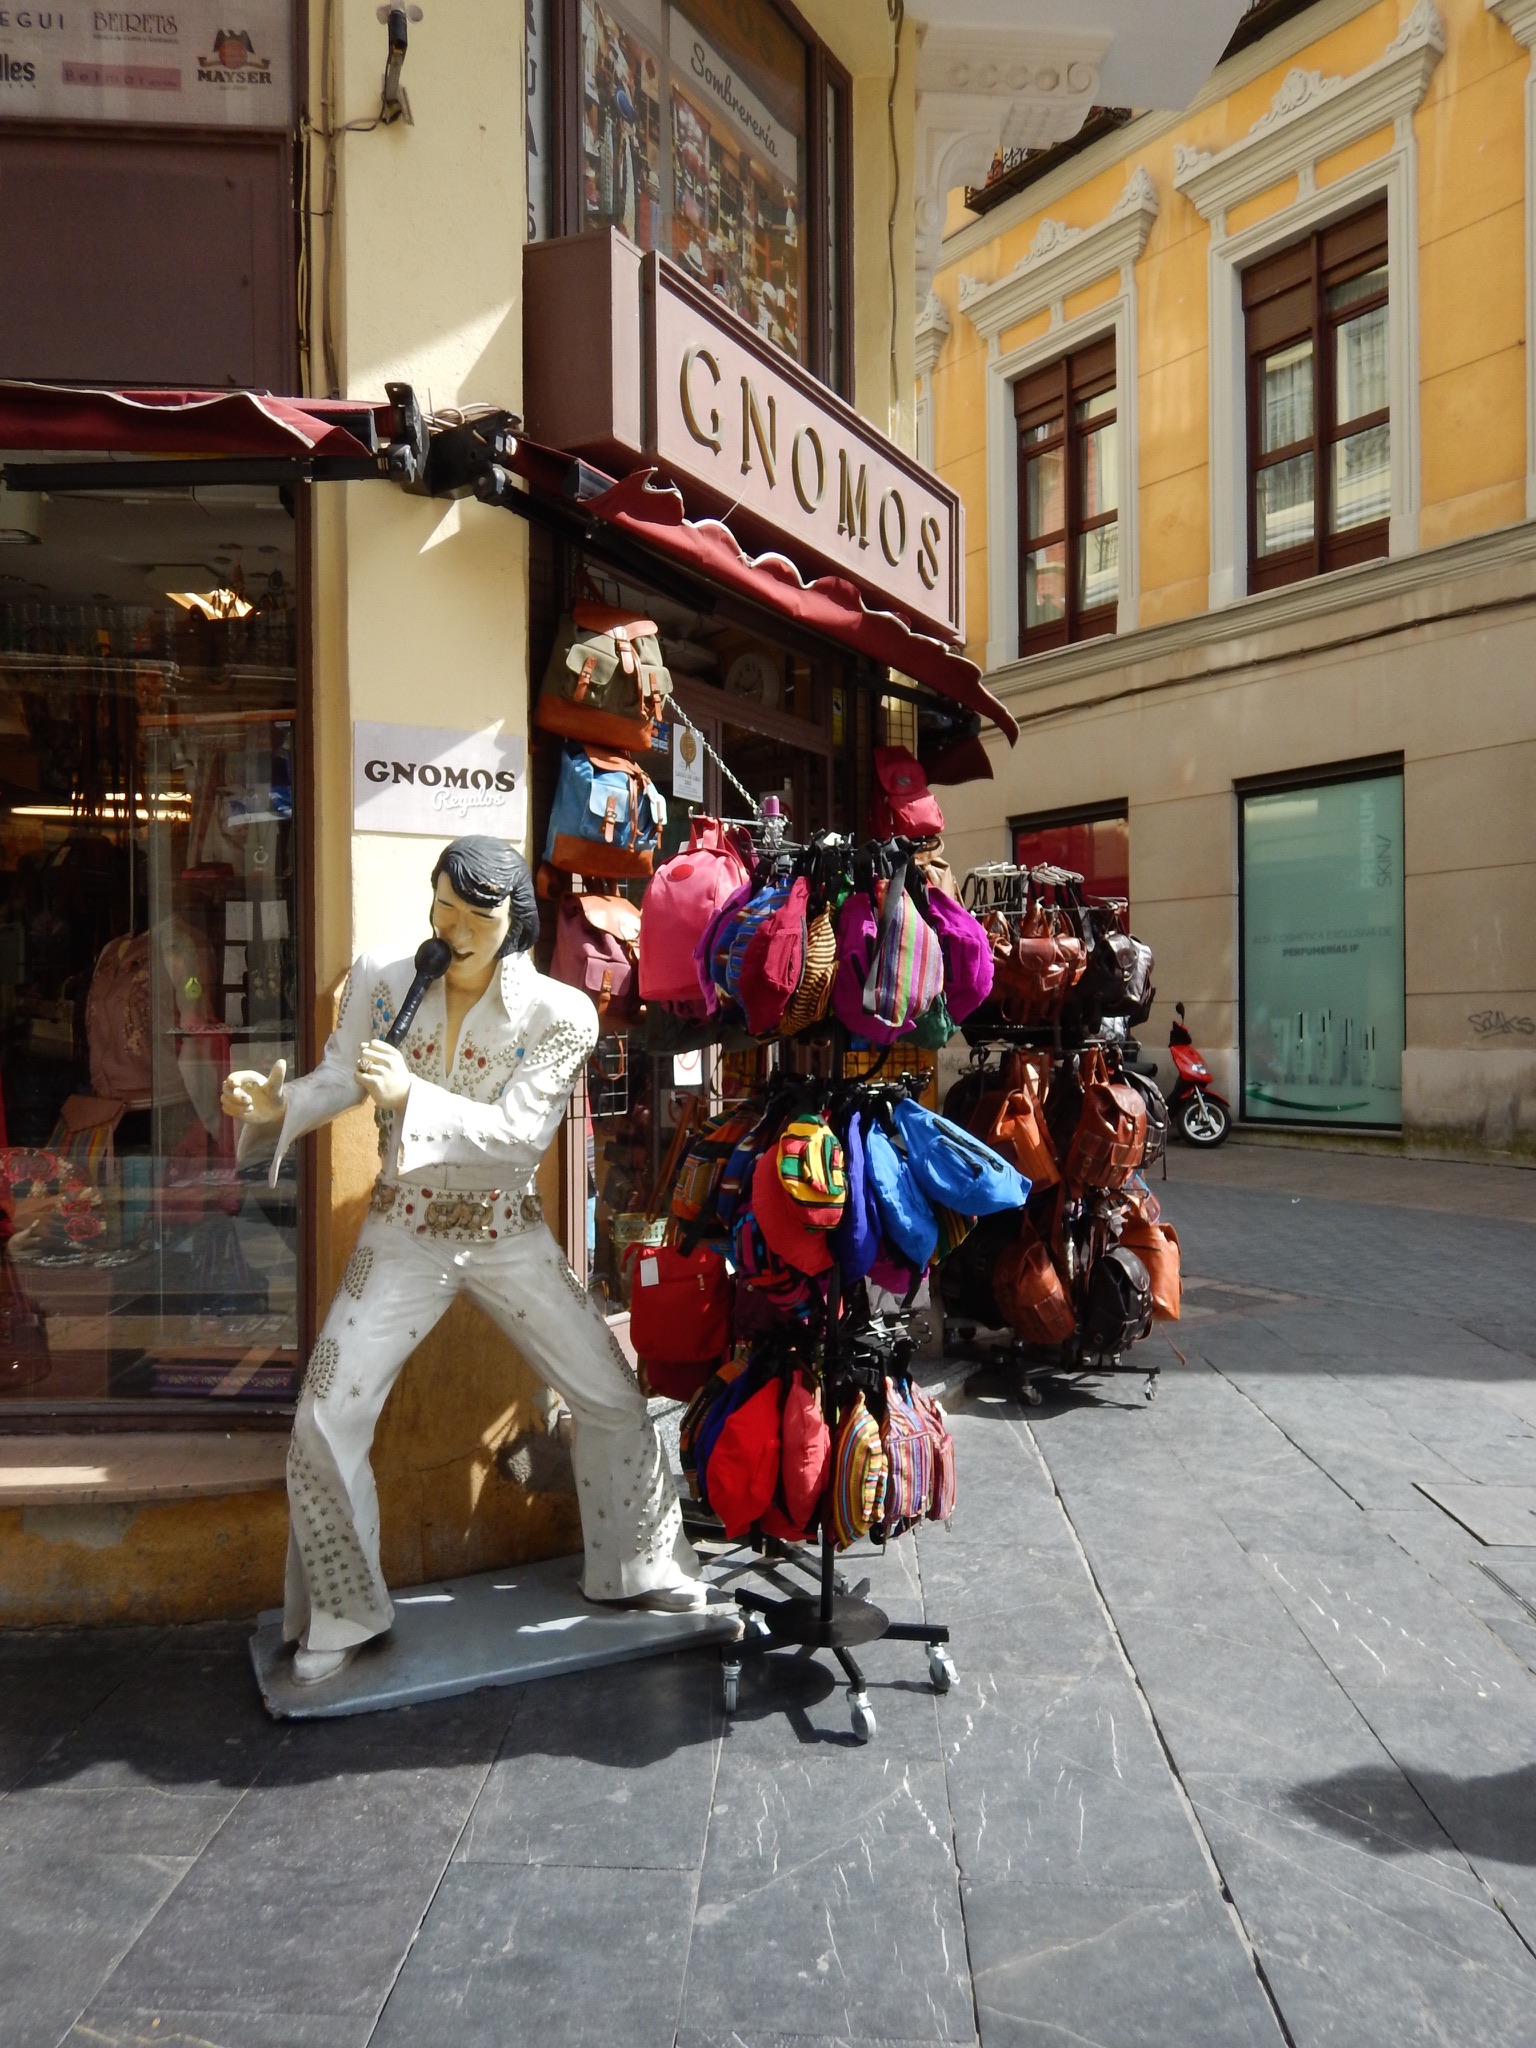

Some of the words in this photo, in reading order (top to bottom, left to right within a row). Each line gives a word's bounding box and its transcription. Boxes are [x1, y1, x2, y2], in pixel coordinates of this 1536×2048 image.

[0, 11, 64, 30] EGUI
[93, 12, 179, 35] BEIRETS
[197, 69, 273, 85] MAYSER
[679, 342, 942, 591] GNOMOS
[364, 759, 515, 793] GNOMOS
[432, 784, 505, 817] Regalos
[1360, 792, 1376, 889] PREMIUM
